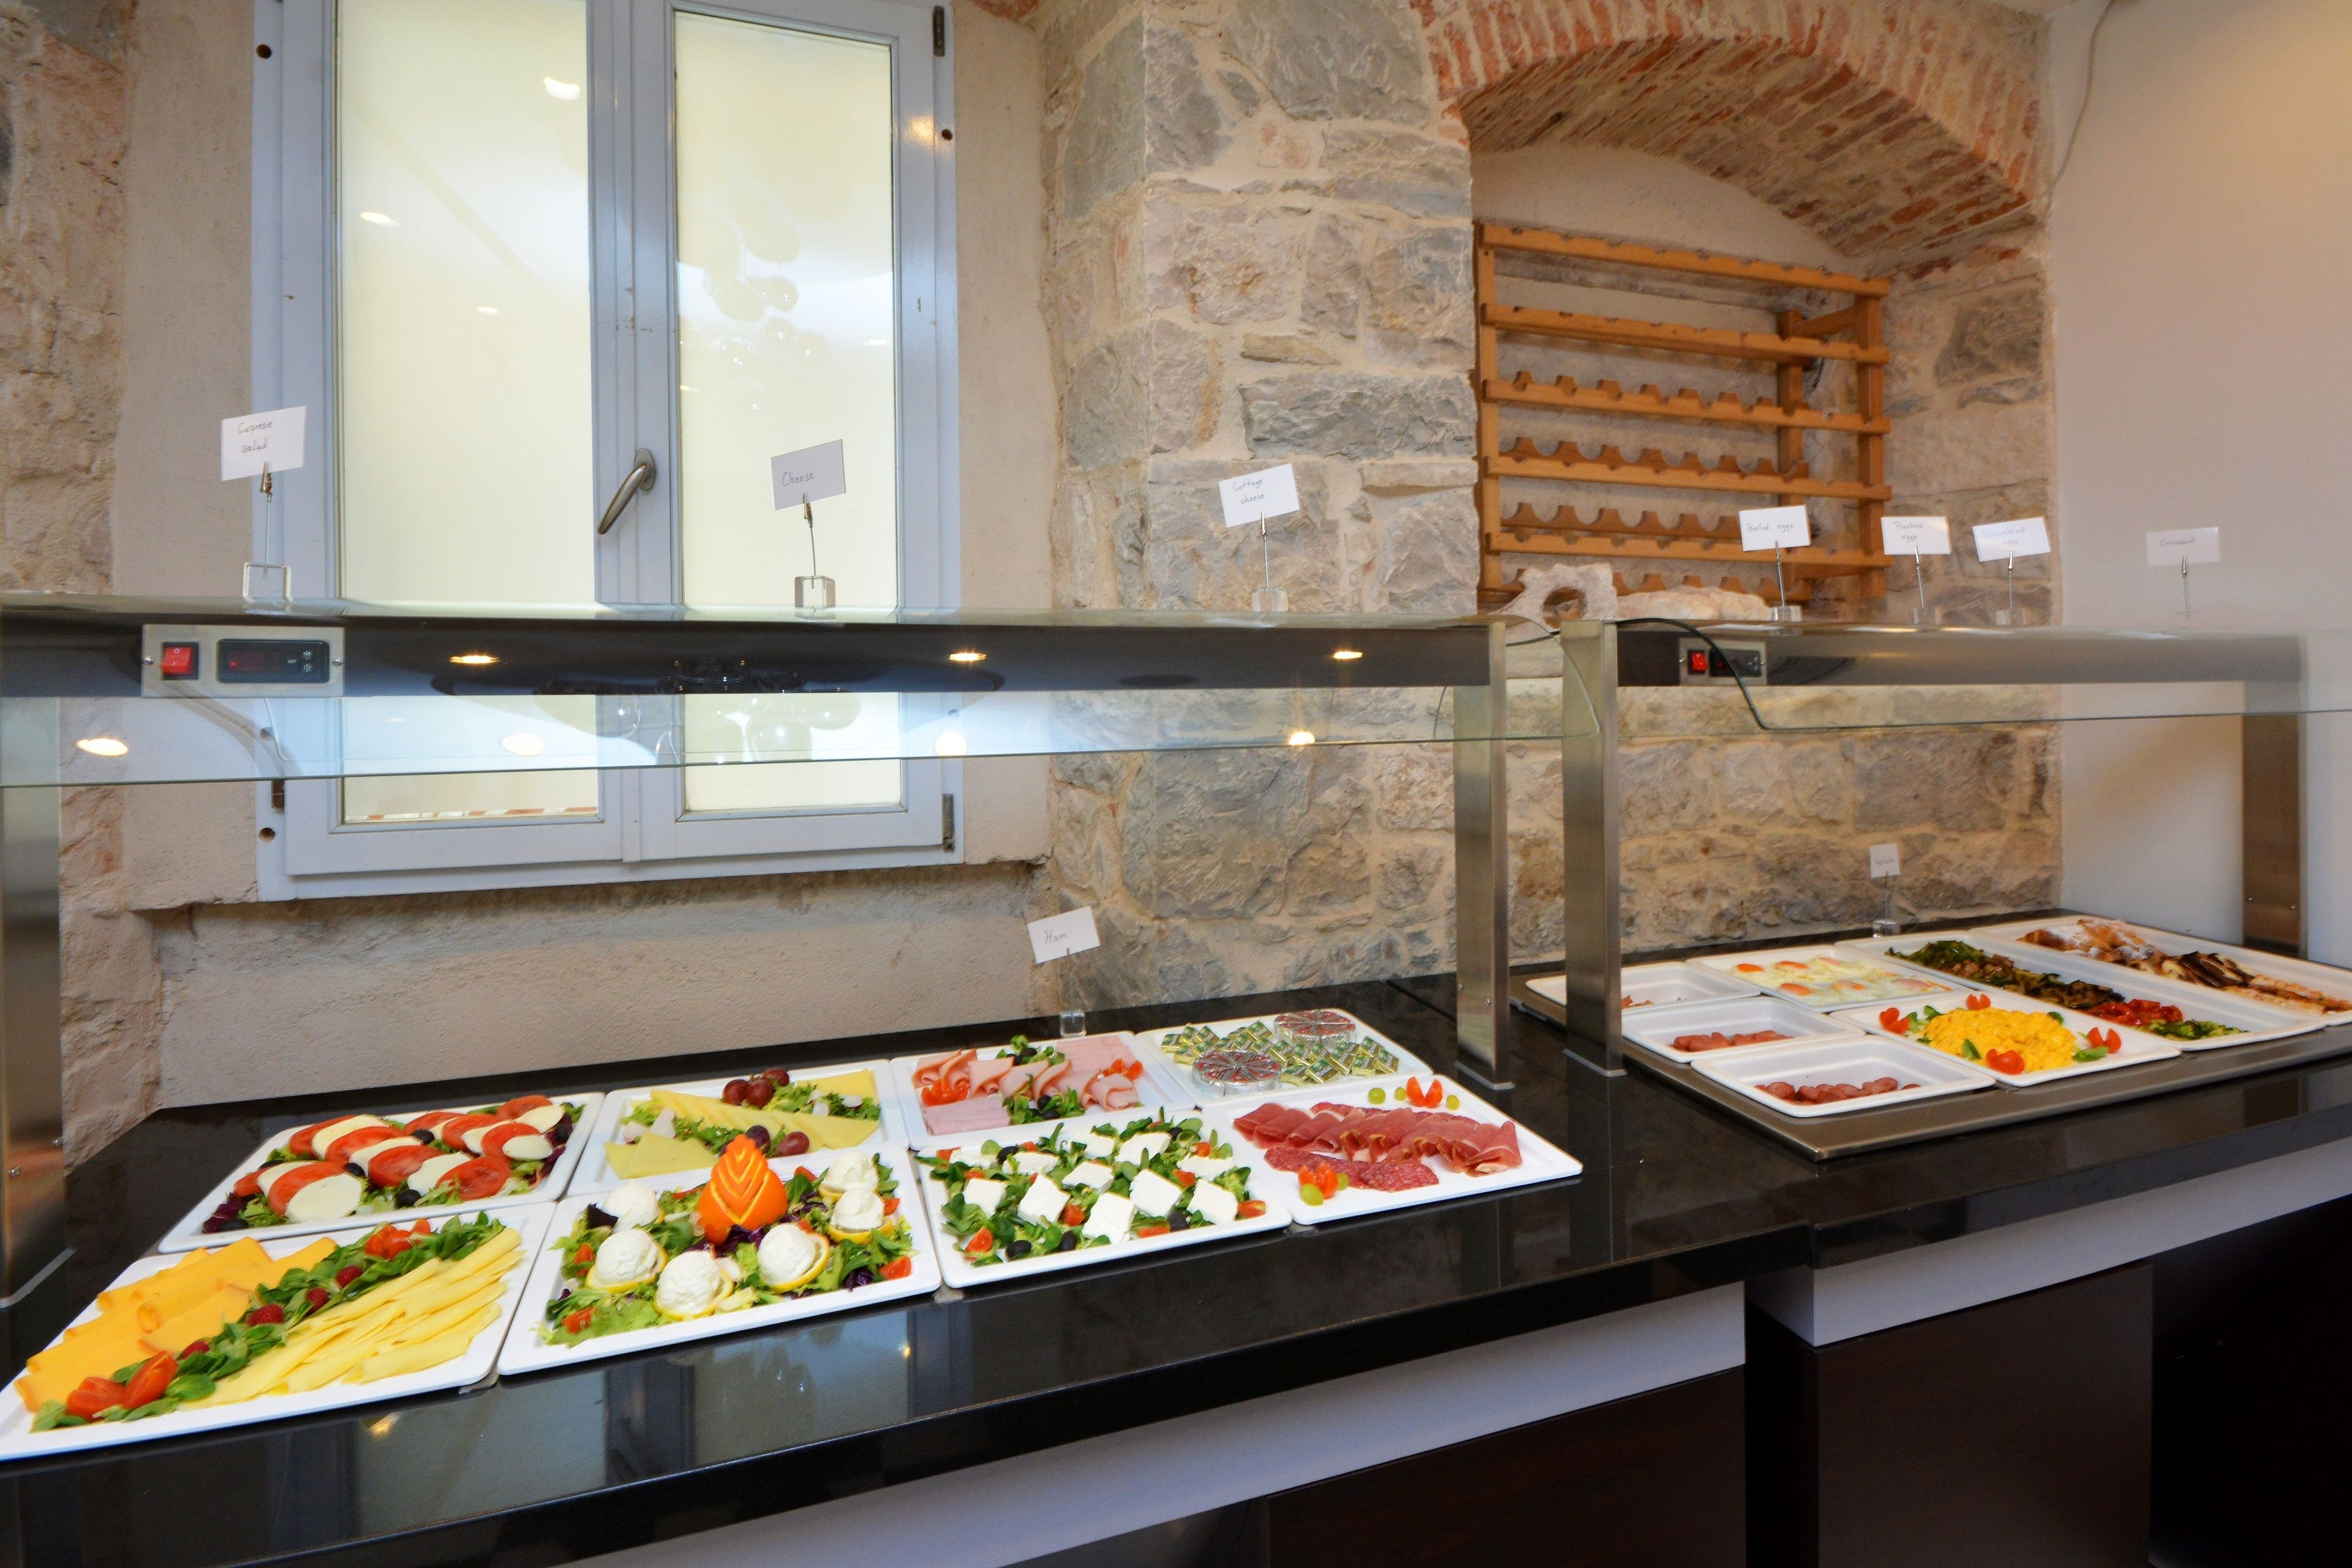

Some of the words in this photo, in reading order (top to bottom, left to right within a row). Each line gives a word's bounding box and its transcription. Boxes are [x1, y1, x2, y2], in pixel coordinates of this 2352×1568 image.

[237, 421, 272, 435] Caprese
[241, 437, 268, 453] salad
[782, 471, 815, 487] Cheese
[1233, 479, 1263, 491] Cottage
[1241, 494, 1264, 504] cheese
[1777, 524, 1793, 532] eggs
[1044, 930, 1068, 945] Ham
